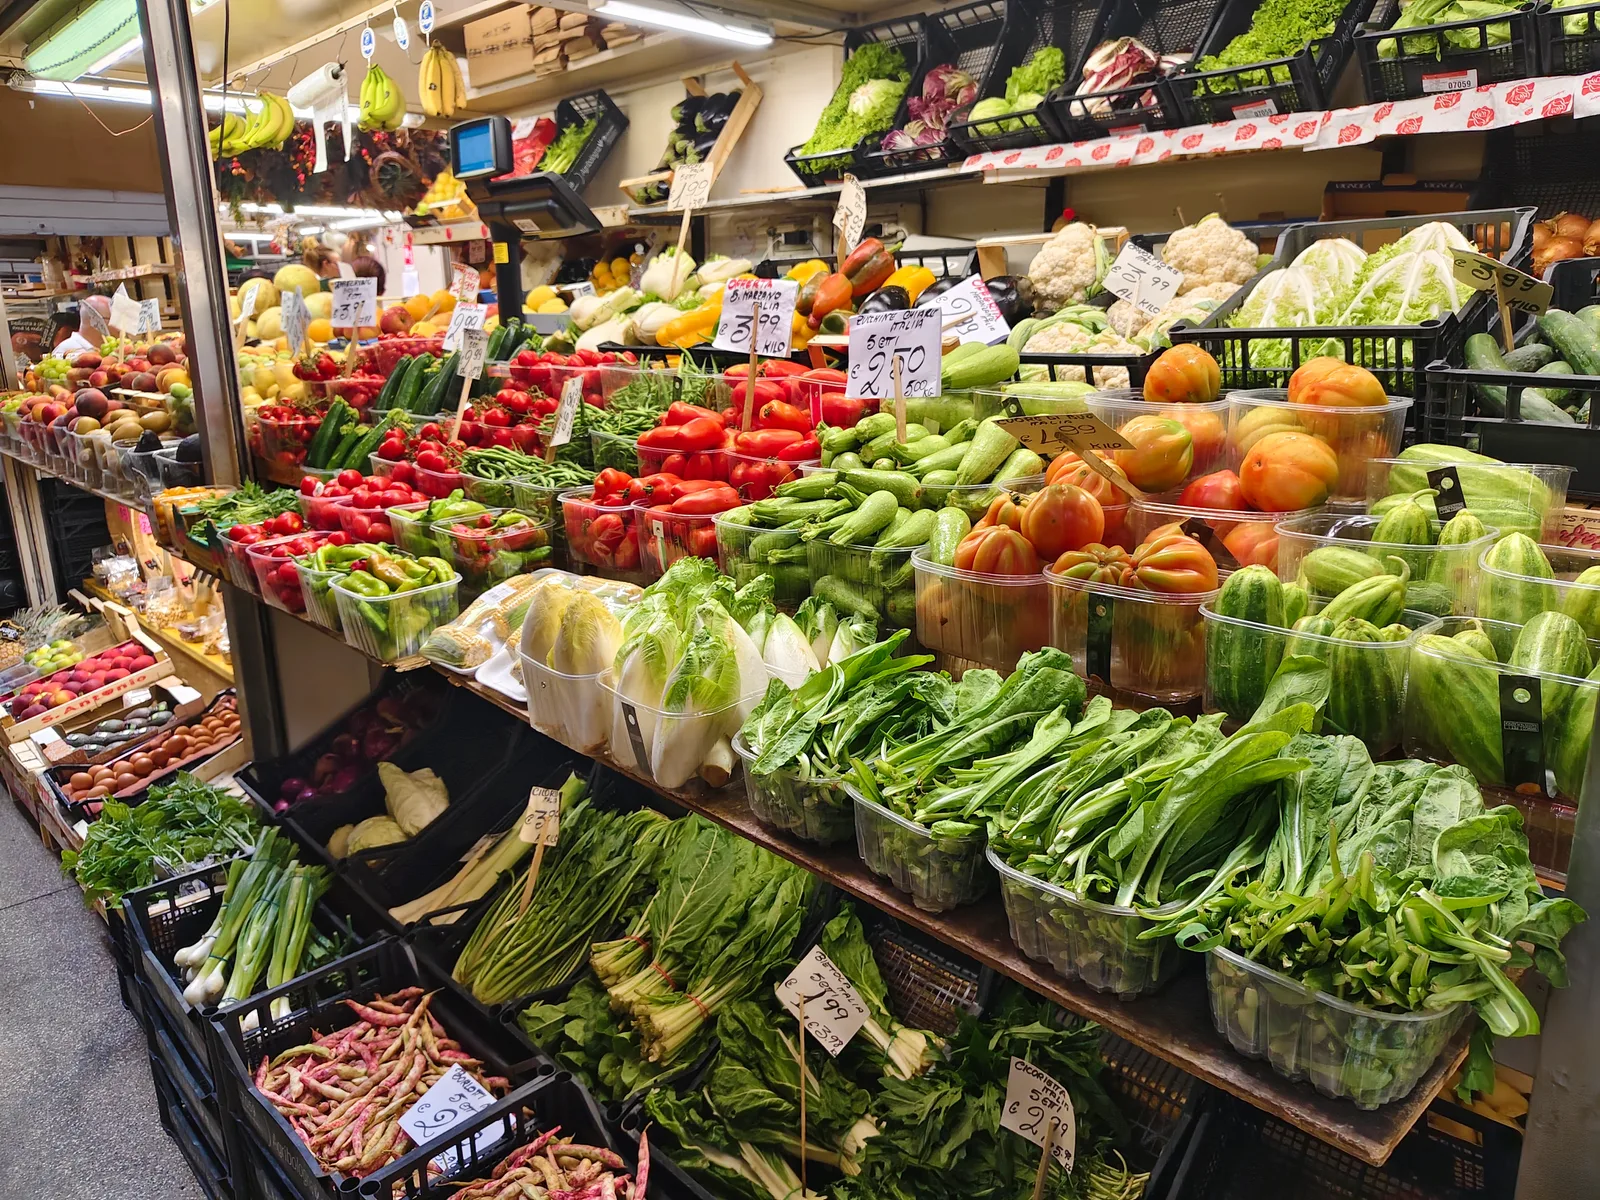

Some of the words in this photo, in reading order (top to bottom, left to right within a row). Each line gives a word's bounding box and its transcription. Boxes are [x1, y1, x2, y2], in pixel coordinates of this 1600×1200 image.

[1448, 80, 1471, 89] 07059
[742, 290, 782, 301] MARZANO
[1115, 288, 1133, 299] AL
[1139, 298, 1160, 314] KILO
[1505, 297, 1540, 312] KILO
[889, 319, 925, 333] ITALIA
[762, 340, 786, 354] KILO
[866, 334, 877, 350] 5
[878, 336, 900, 349] ETTI
[810, 972, 826, 982] 5
[815, 951, 851, 989] BIETOLA
[448, 1092, 468, 1103] 5
[1029, 1088, 1043, 1101] 5
